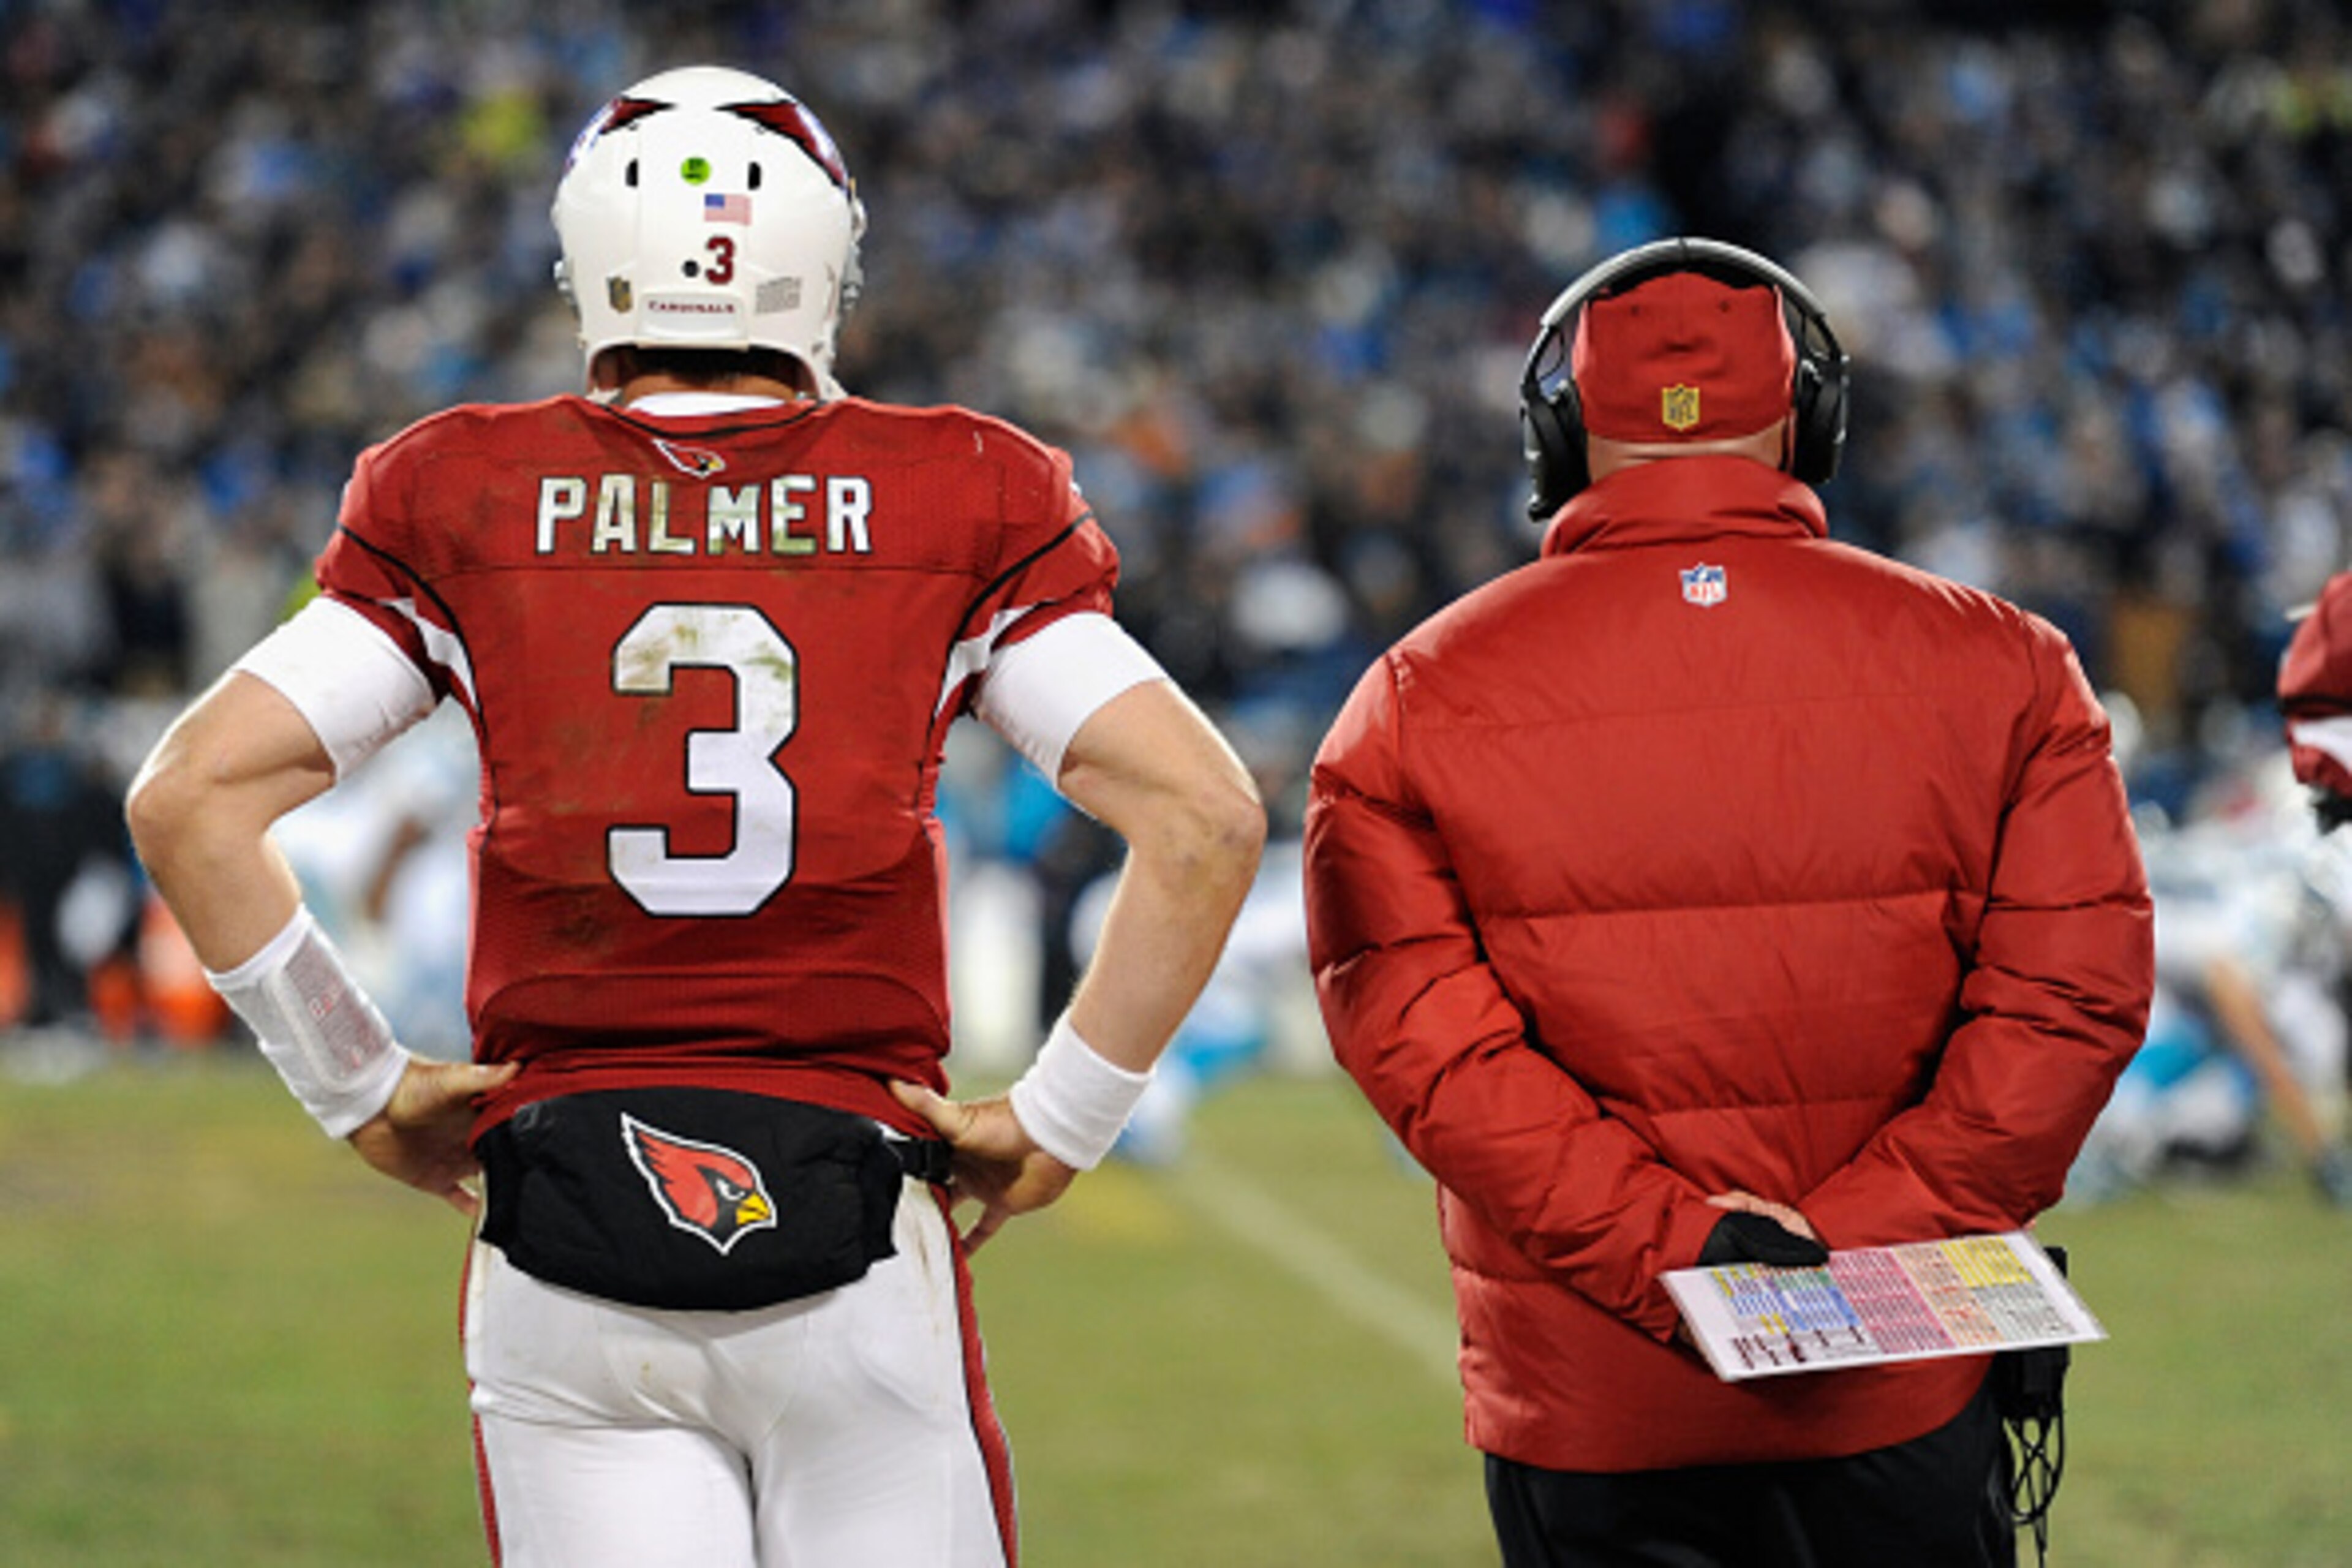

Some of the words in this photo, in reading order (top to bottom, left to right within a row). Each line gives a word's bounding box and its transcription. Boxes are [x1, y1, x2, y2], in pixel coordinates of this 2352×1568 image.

[705, 234, 736, 285] 3
[647, 300, 736, 314] CARDINALS
[535, 473, 872, 554] PALMER
[606, 601, 799, 918] 3
